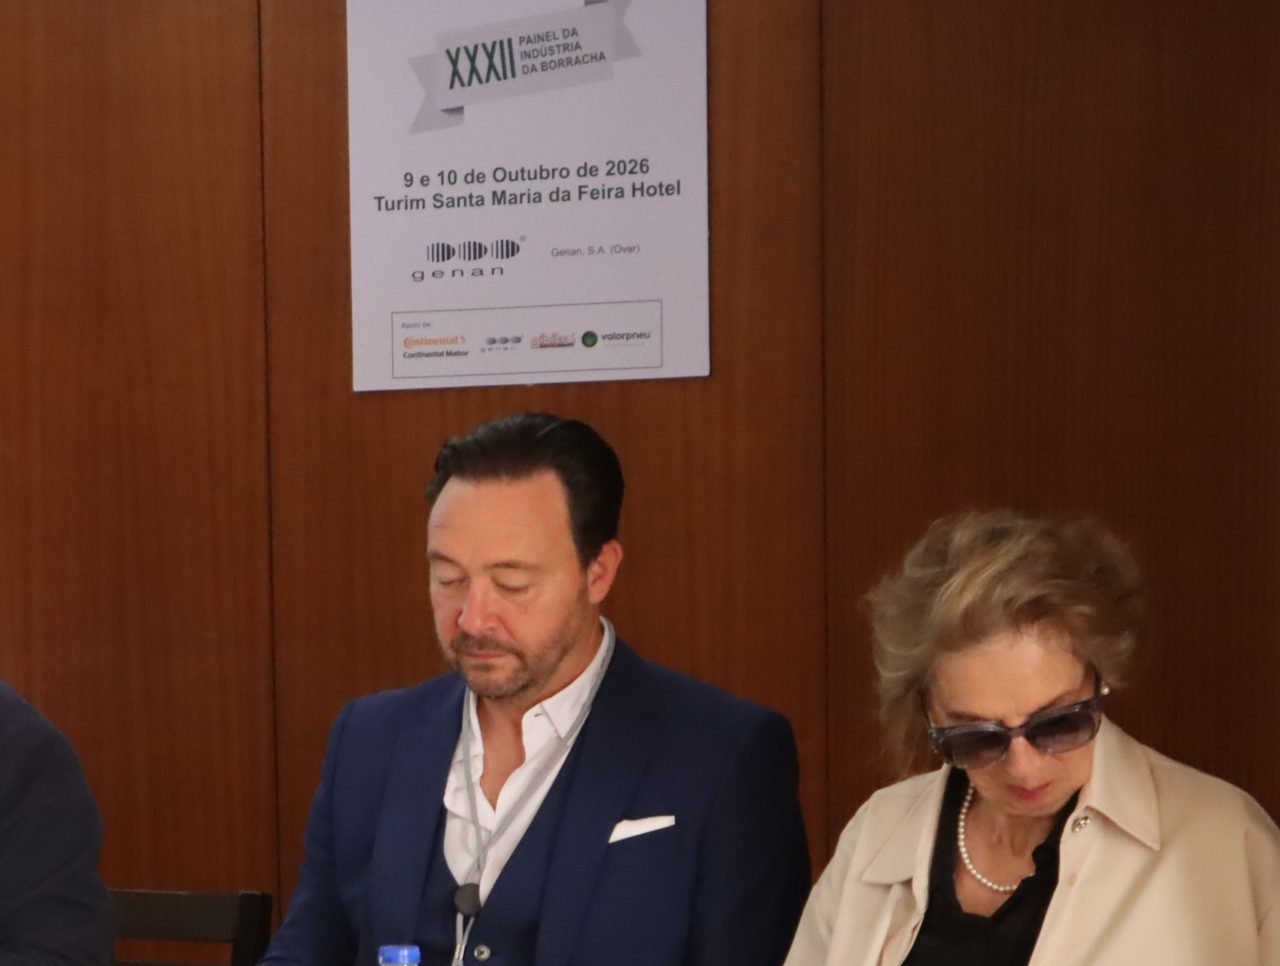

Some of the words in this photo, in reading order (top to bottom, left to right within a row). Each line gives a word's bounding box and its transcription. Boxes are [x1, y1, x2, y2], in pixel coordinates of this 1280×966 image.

[519, 31, 559, 46] PAINEL
[562, 27, 579, 40] DA
[446, 37, 516, 90] XXXII
[522, 63, 538, 75] DA
[541, 51, 607, 73] BORRACHA
[403, 172, 414, 187] 9
[420, 174, 430, 187] e
[437, 169, 457, 186] 10
[464, 169, 486, 184] de
[492, 164, 570, 183] Outubro
[577, 162, 599, 178] de
[605, 158, 650, 176] 2026
[373, 195, 426, 212] Turim
[432, 192, 485, 209] Santa
[491, 188, 542, 206] Maria
[549, 187, 571, 202] da
[578, 184, 625, 201] Feira
[631, 179, 681, 198] Hotel
[411, 265, 505, 282] genan
